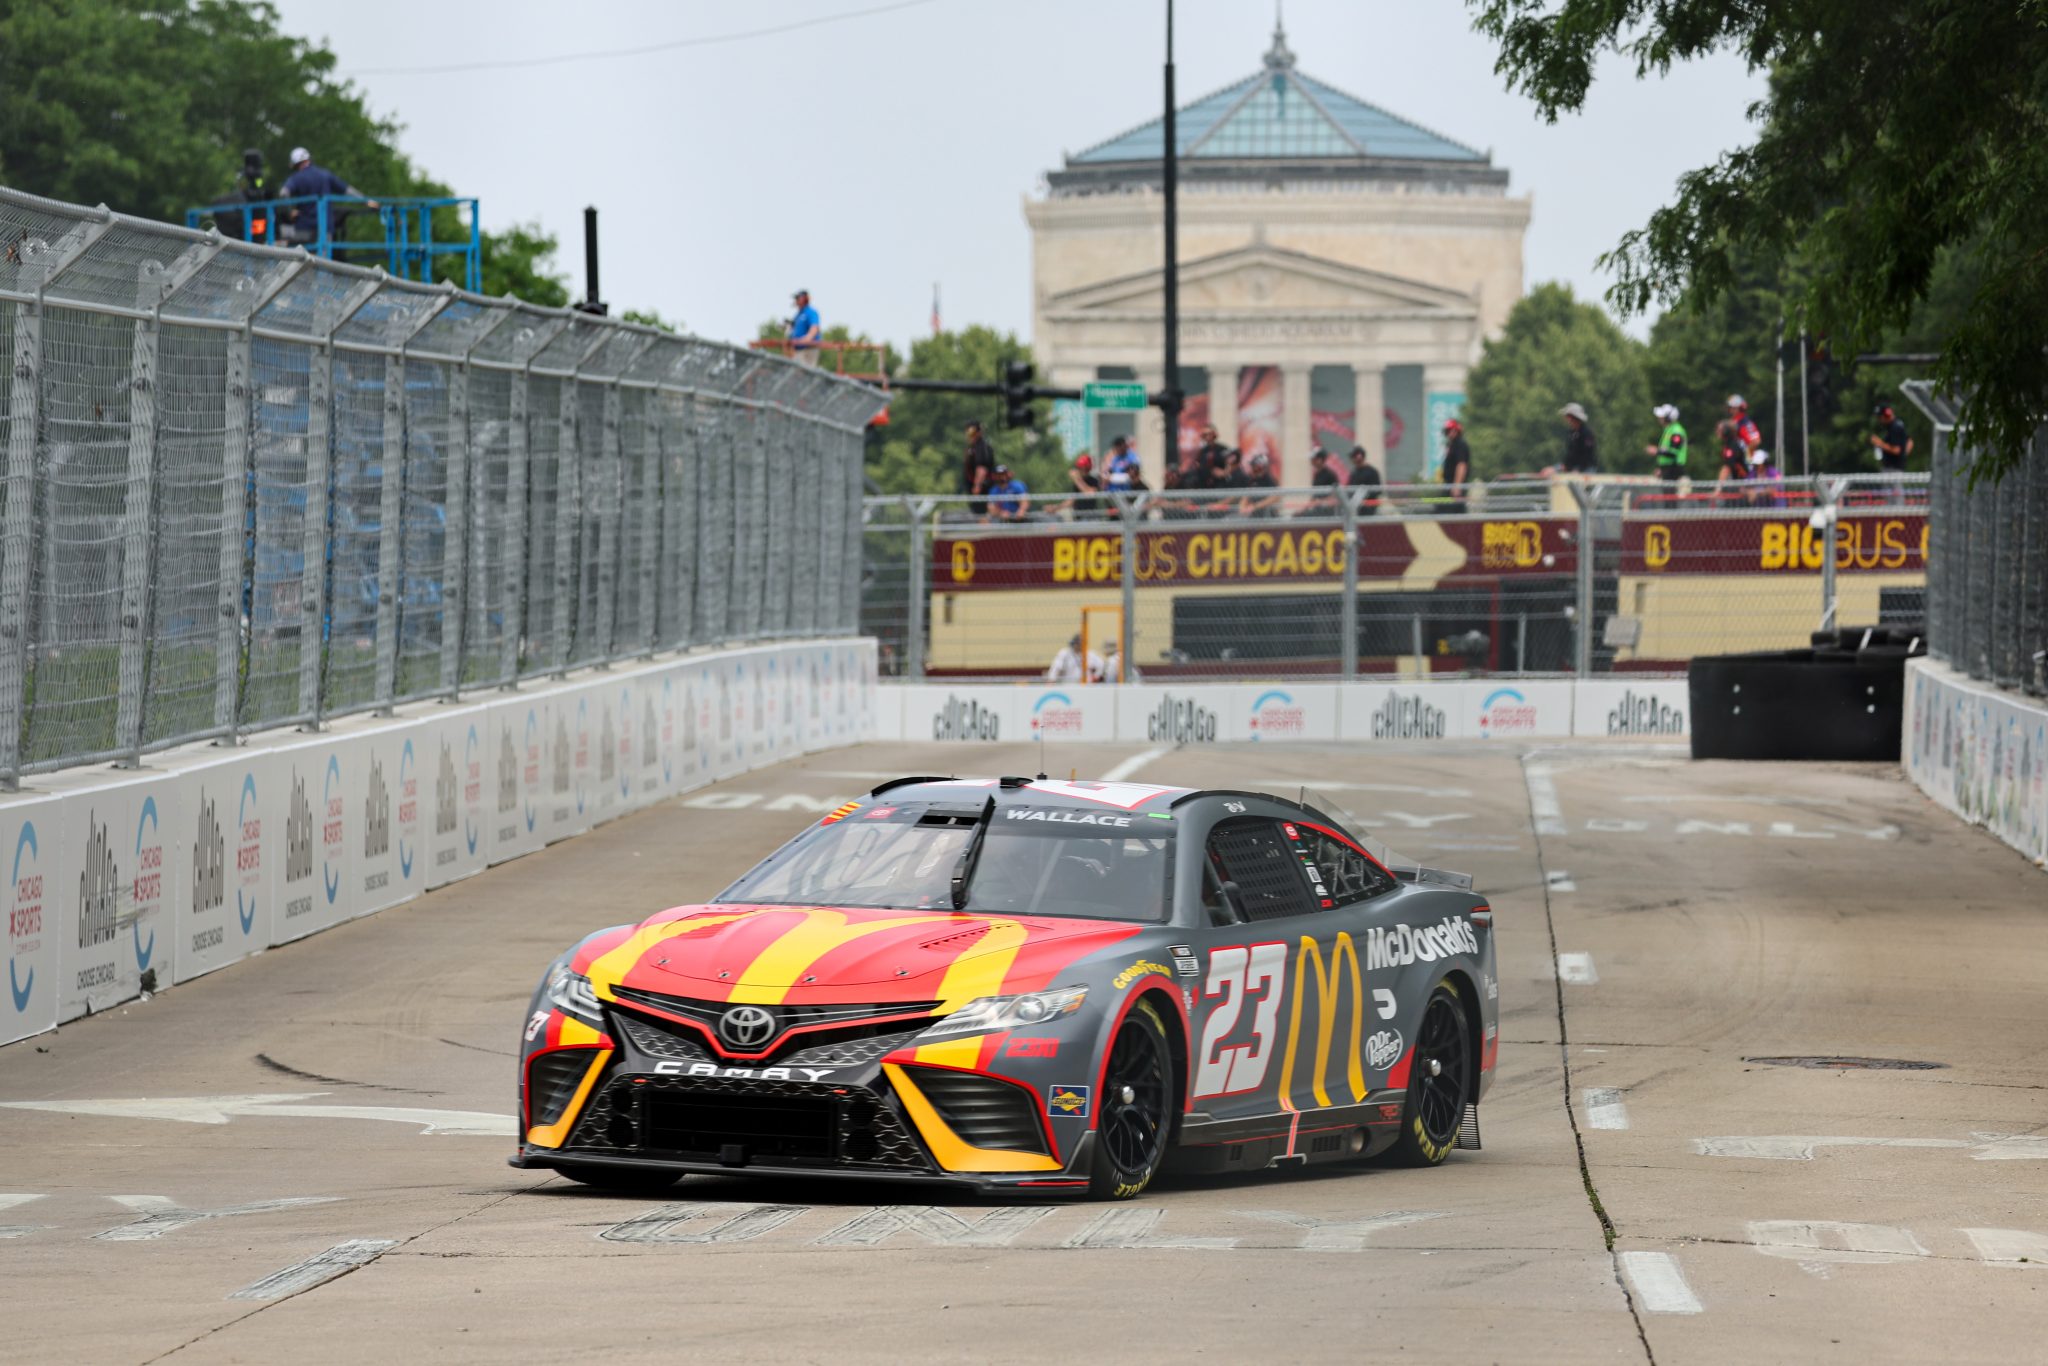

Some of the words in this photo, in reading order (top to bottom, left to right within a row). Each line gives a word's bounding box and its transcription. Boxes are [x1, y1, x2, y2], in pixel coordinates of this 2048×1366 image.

[1187, 529, 1347, 577] CHICAGO
[1607, 689, 1683, 735] CHICAGO
[1007, 809, 1133, 828] WALLACE
[140, 845, 163, 870] CHICAGO
[241, 844, 261, 871] SPORTS
[18, 875, 44, 903] CHICAGO
[79, 808, 119, 949] CHICAGO
[139, 872, 162, 902] SPORTS
[16, 904, 42, 938] SPORTS
[1367, 915, 1479, 971] McDonald's
[77, 966, 95, 990] CHOOSE
[95, 962, 116, 986] CHICAGO
[1112, 959, 1172, 990] GOODYEAR
[1194, 940, 1288, 1099] 23
[1369, 1034, 1401, 1066] Pepper
[1375, 1030, 1392, 1048] Dr
